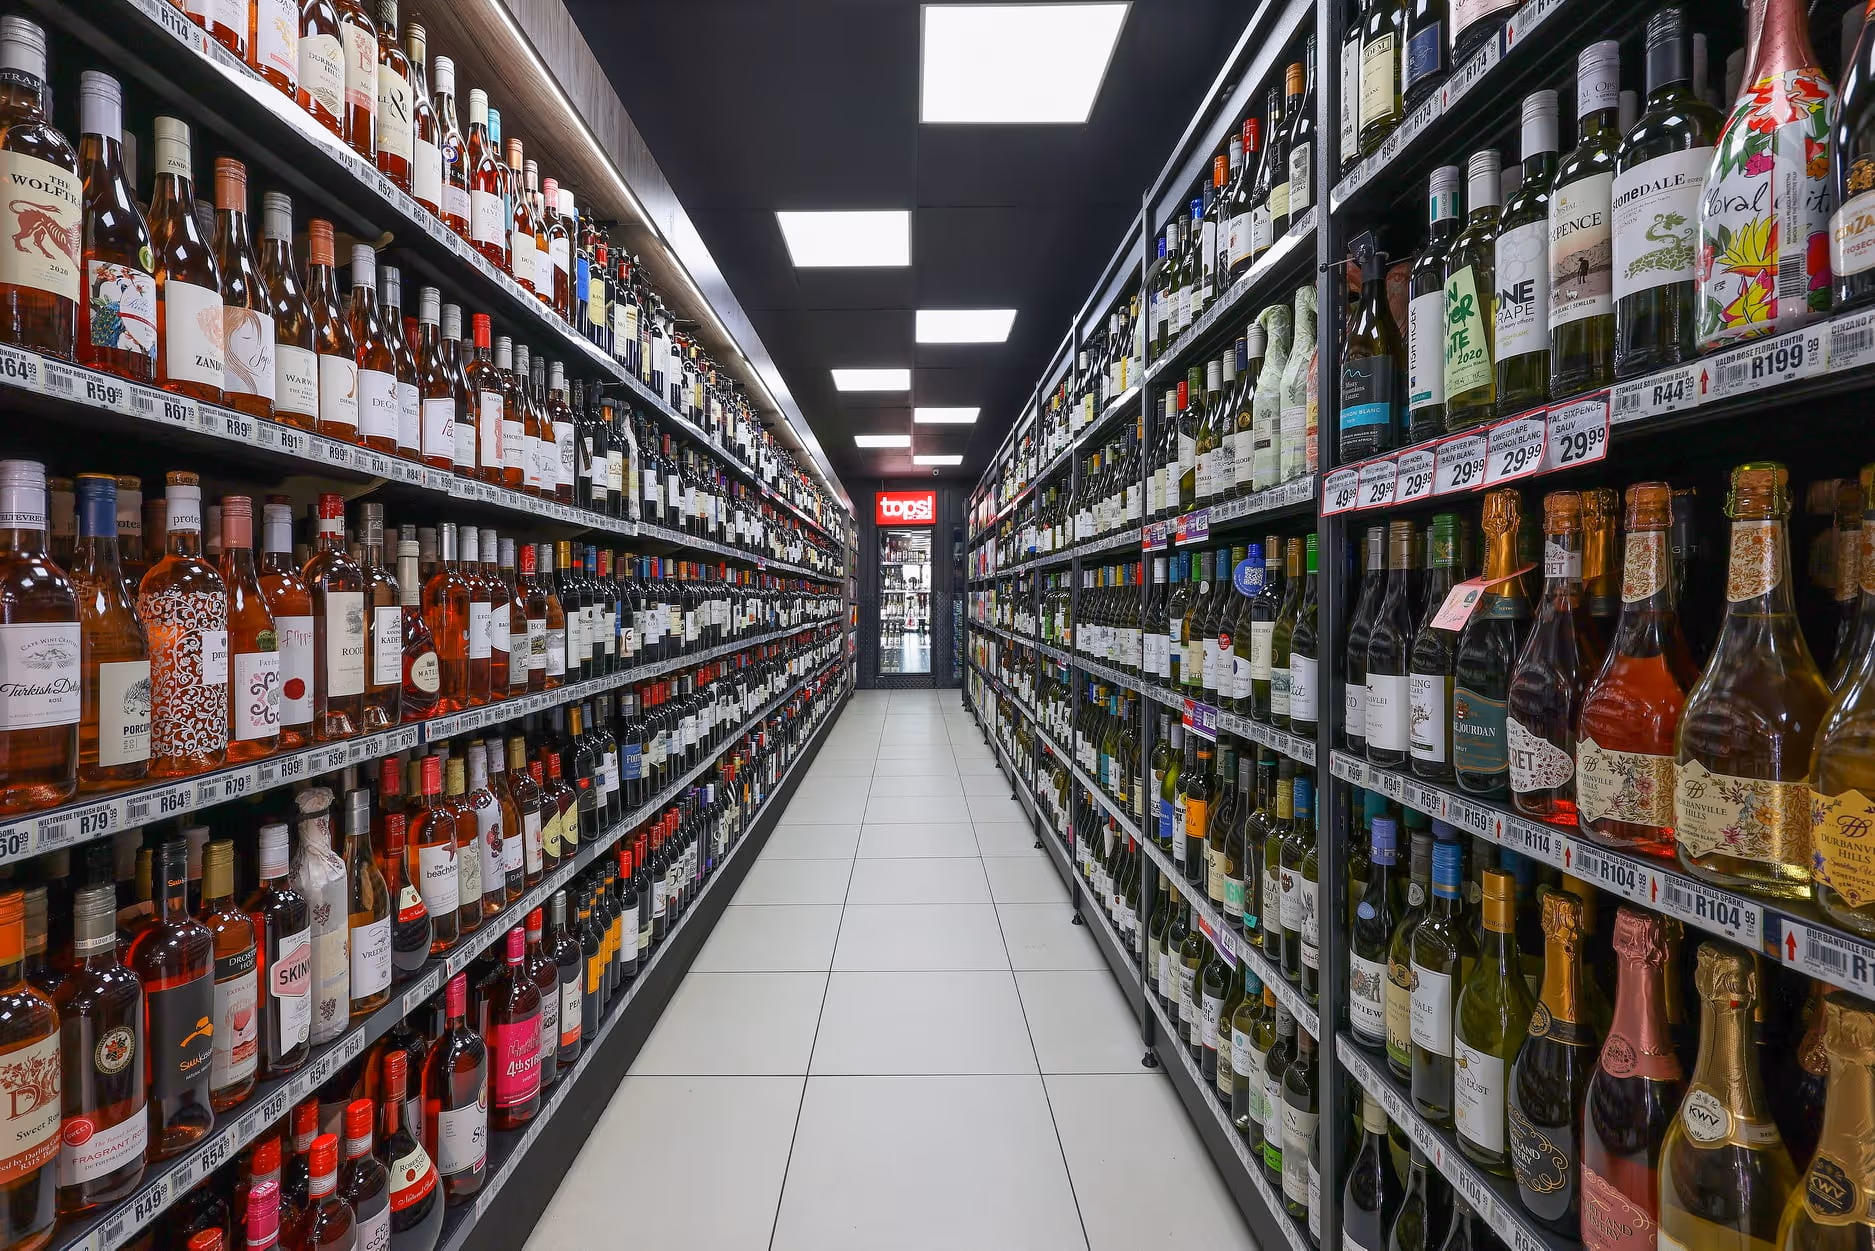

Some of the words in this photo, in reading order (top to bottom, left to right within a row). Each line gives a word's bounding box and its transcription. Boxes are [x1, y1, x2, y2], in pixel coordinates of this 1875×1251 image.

[49, 174, 71, 190] THE
[49, 264, 69, 276] 2020
[1831, 317, 1866, 334] CINZANO
[1457, 348, 1483, 365] 2020
[1715, 355, 1736, 367] VALDO
[1736, 350, 1752, 362] ROSE
[1755, 342, 1779, 357] FLORAL
[1780, 333, 1804, 347] EDITIO
[44, 363, 72, 376] WOLFTRAP
[73, 371, 87, 380] ROSE
[1752, 344, 1804, 379] R199
[1653, 380, 1684, 406] R44
[1359, 407, 1381, 415] BLANC
[1563, 403, 1601, 421] SIXPENCE
[1492, 423, 1528, 442] ONEGRAPE
[1518, 430, 1541, 444] BLANC
[1555, 421, 1576, 433] SAUV
[1468, 437, 1486, 448] WHITE
[1560, 427, 1605, 463] 29.99
[1457, 449, 1475, 460] BLANC
[1501, 443, 1542, 476] 29.99
[1451, 458, 1485, 486] 29.99
[1369, 482, 1395, 503] 29.99
[1405, 472, 1433, 497] 29.99
[880, 496, 932, 520] tops!
[1336, 488, 1357, 508] 49.99
[0, 683, 52, 697] Turkish
[38, 812, 72, 827] WELTEVREDE
[74, 808, 95, 819] TURKISH
[97, 804, 110, 813] DELIG
[81, 811, 108, 835] R79
[1465, 808, 1487, 831] R159
[1685, 807, 1707, 820] HILLS
[1525, 829, 1550, 854] R114
[1577, 842, 1605, 857] DURBANVILLE
[1605, 852, 1620, 863] HILLS
[1838, 848, 1871, 864] HILLS
[1601, 860, 1636, 890] R104
[1664, 875, 1702, 894] DURBANVILLE
[1702, 886, 1719, 899] HILLS
[1696, 894, 1741, 930] R104
[1807, 928, 1860, 954] DURBANVILLE
[506, 1059, 525, 1077] 4th
[1689, 1106, 1720, 1126] KWV
[16, 1122, 46, 1141] Sweet
[66, 1125, 90, 1140] SWEET
[72, 1137, 130, 1165] FRAGRANT
[201, 1149, 224, 1174] R54
[136, 1190, 161, 1222] R49
